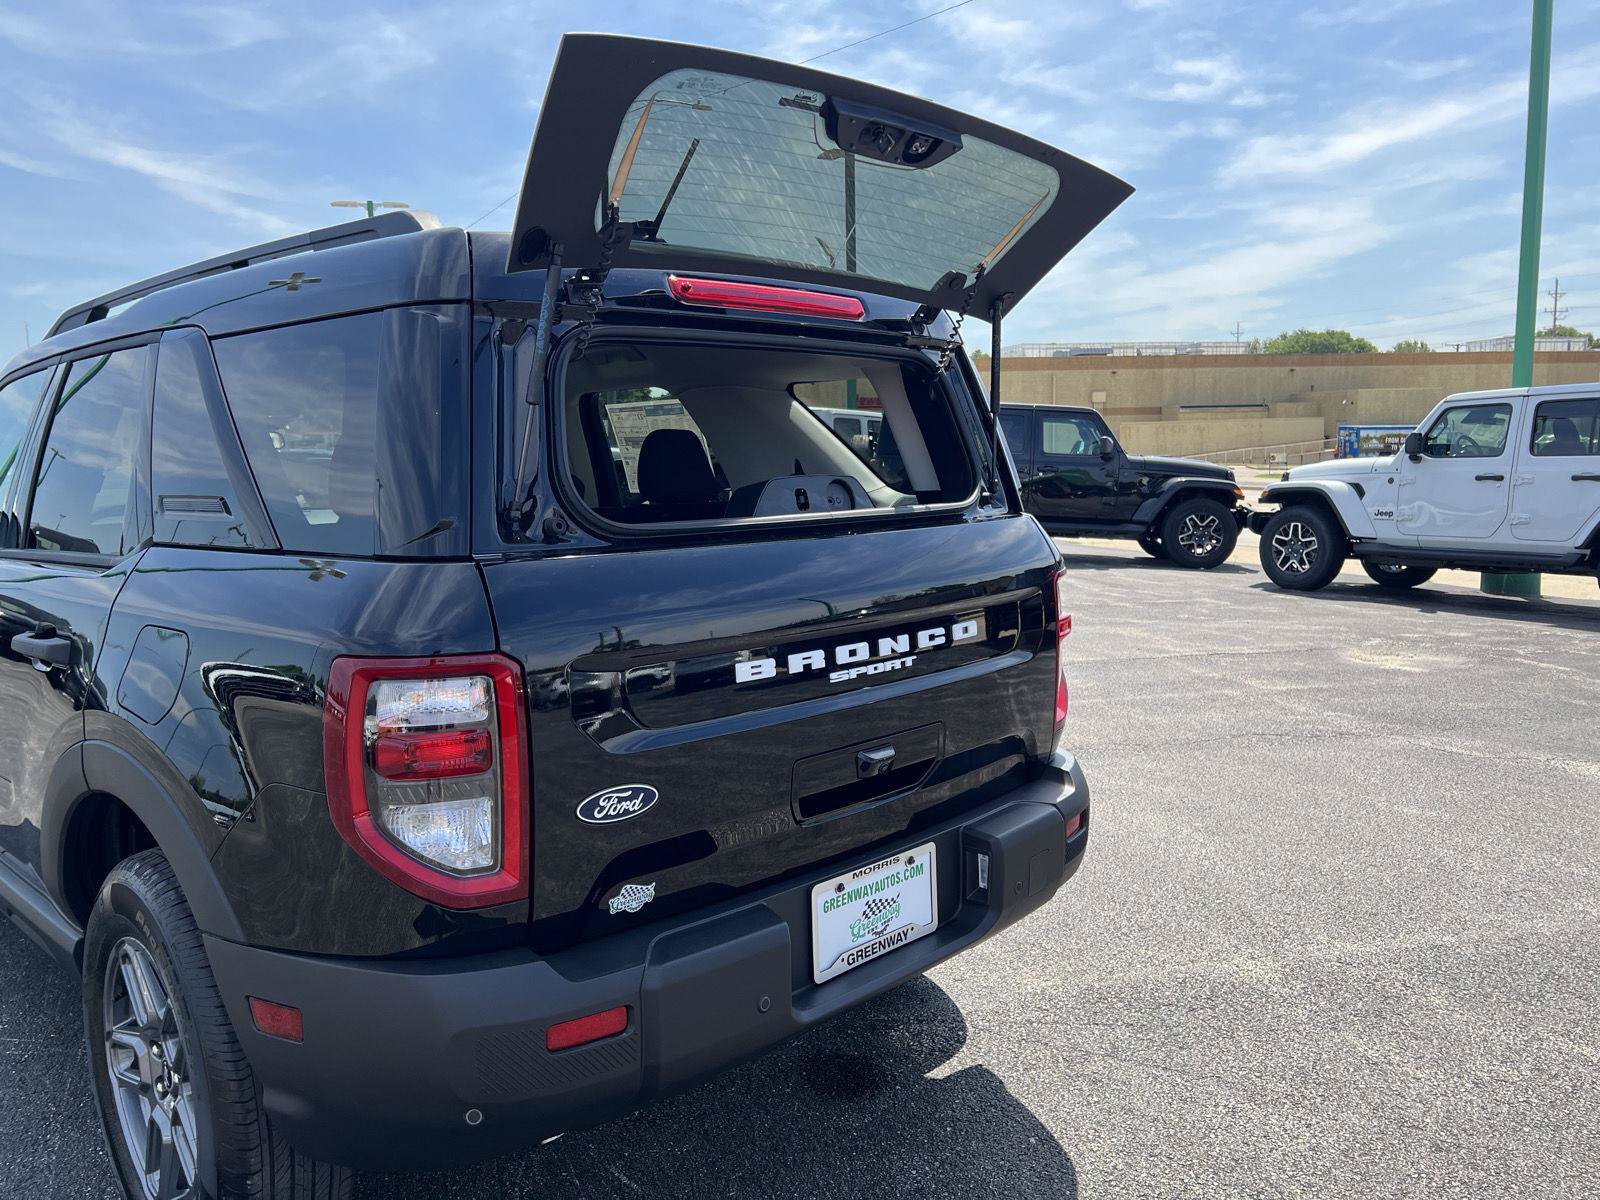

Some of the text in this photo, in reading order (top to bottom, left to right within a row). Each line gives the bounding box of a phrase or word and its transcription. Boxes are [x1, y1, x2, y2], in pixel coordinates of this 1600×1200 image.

[1374, 509, 1394, 518] Jeep
[735, 620, 978, 684] BRONCO
[829, 655, 918, 683] SPORT
[593, 790, 645, 819] Ford
[852, 856, 901, 880] MORRIS
[823, 862, 924, 914] GREENWAYAUTOS.COM
[849, 903, 901, 943] Greenway
[847, 929, 909, 966] GREENWAY
